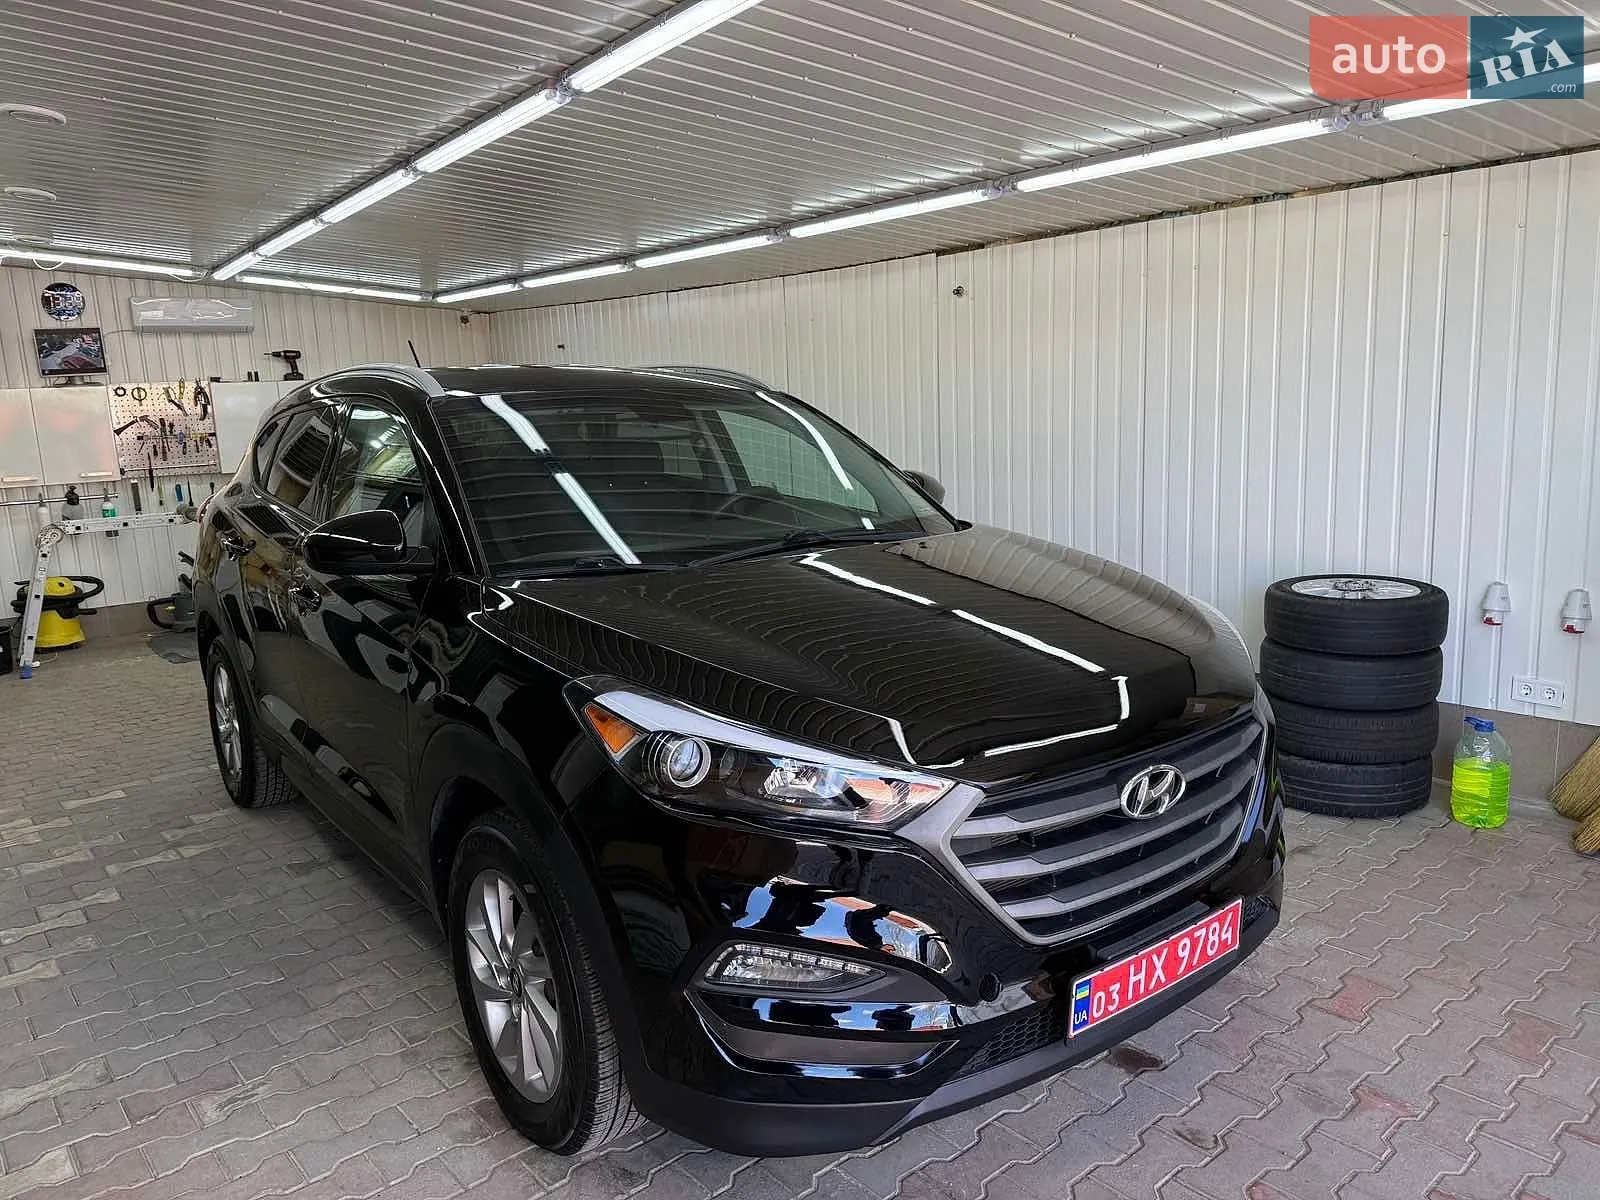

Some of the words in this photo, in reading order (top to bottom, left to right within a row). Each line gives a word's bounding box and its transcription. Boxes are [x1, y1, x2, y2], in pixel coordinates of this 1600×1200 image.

[1092, 983, 1121, 1018] 03
[1127, 947, 1168, 1001] HX
[1177, 912, 1233, 975] 9784
[1074, 1011, 1088, 1025] UA
